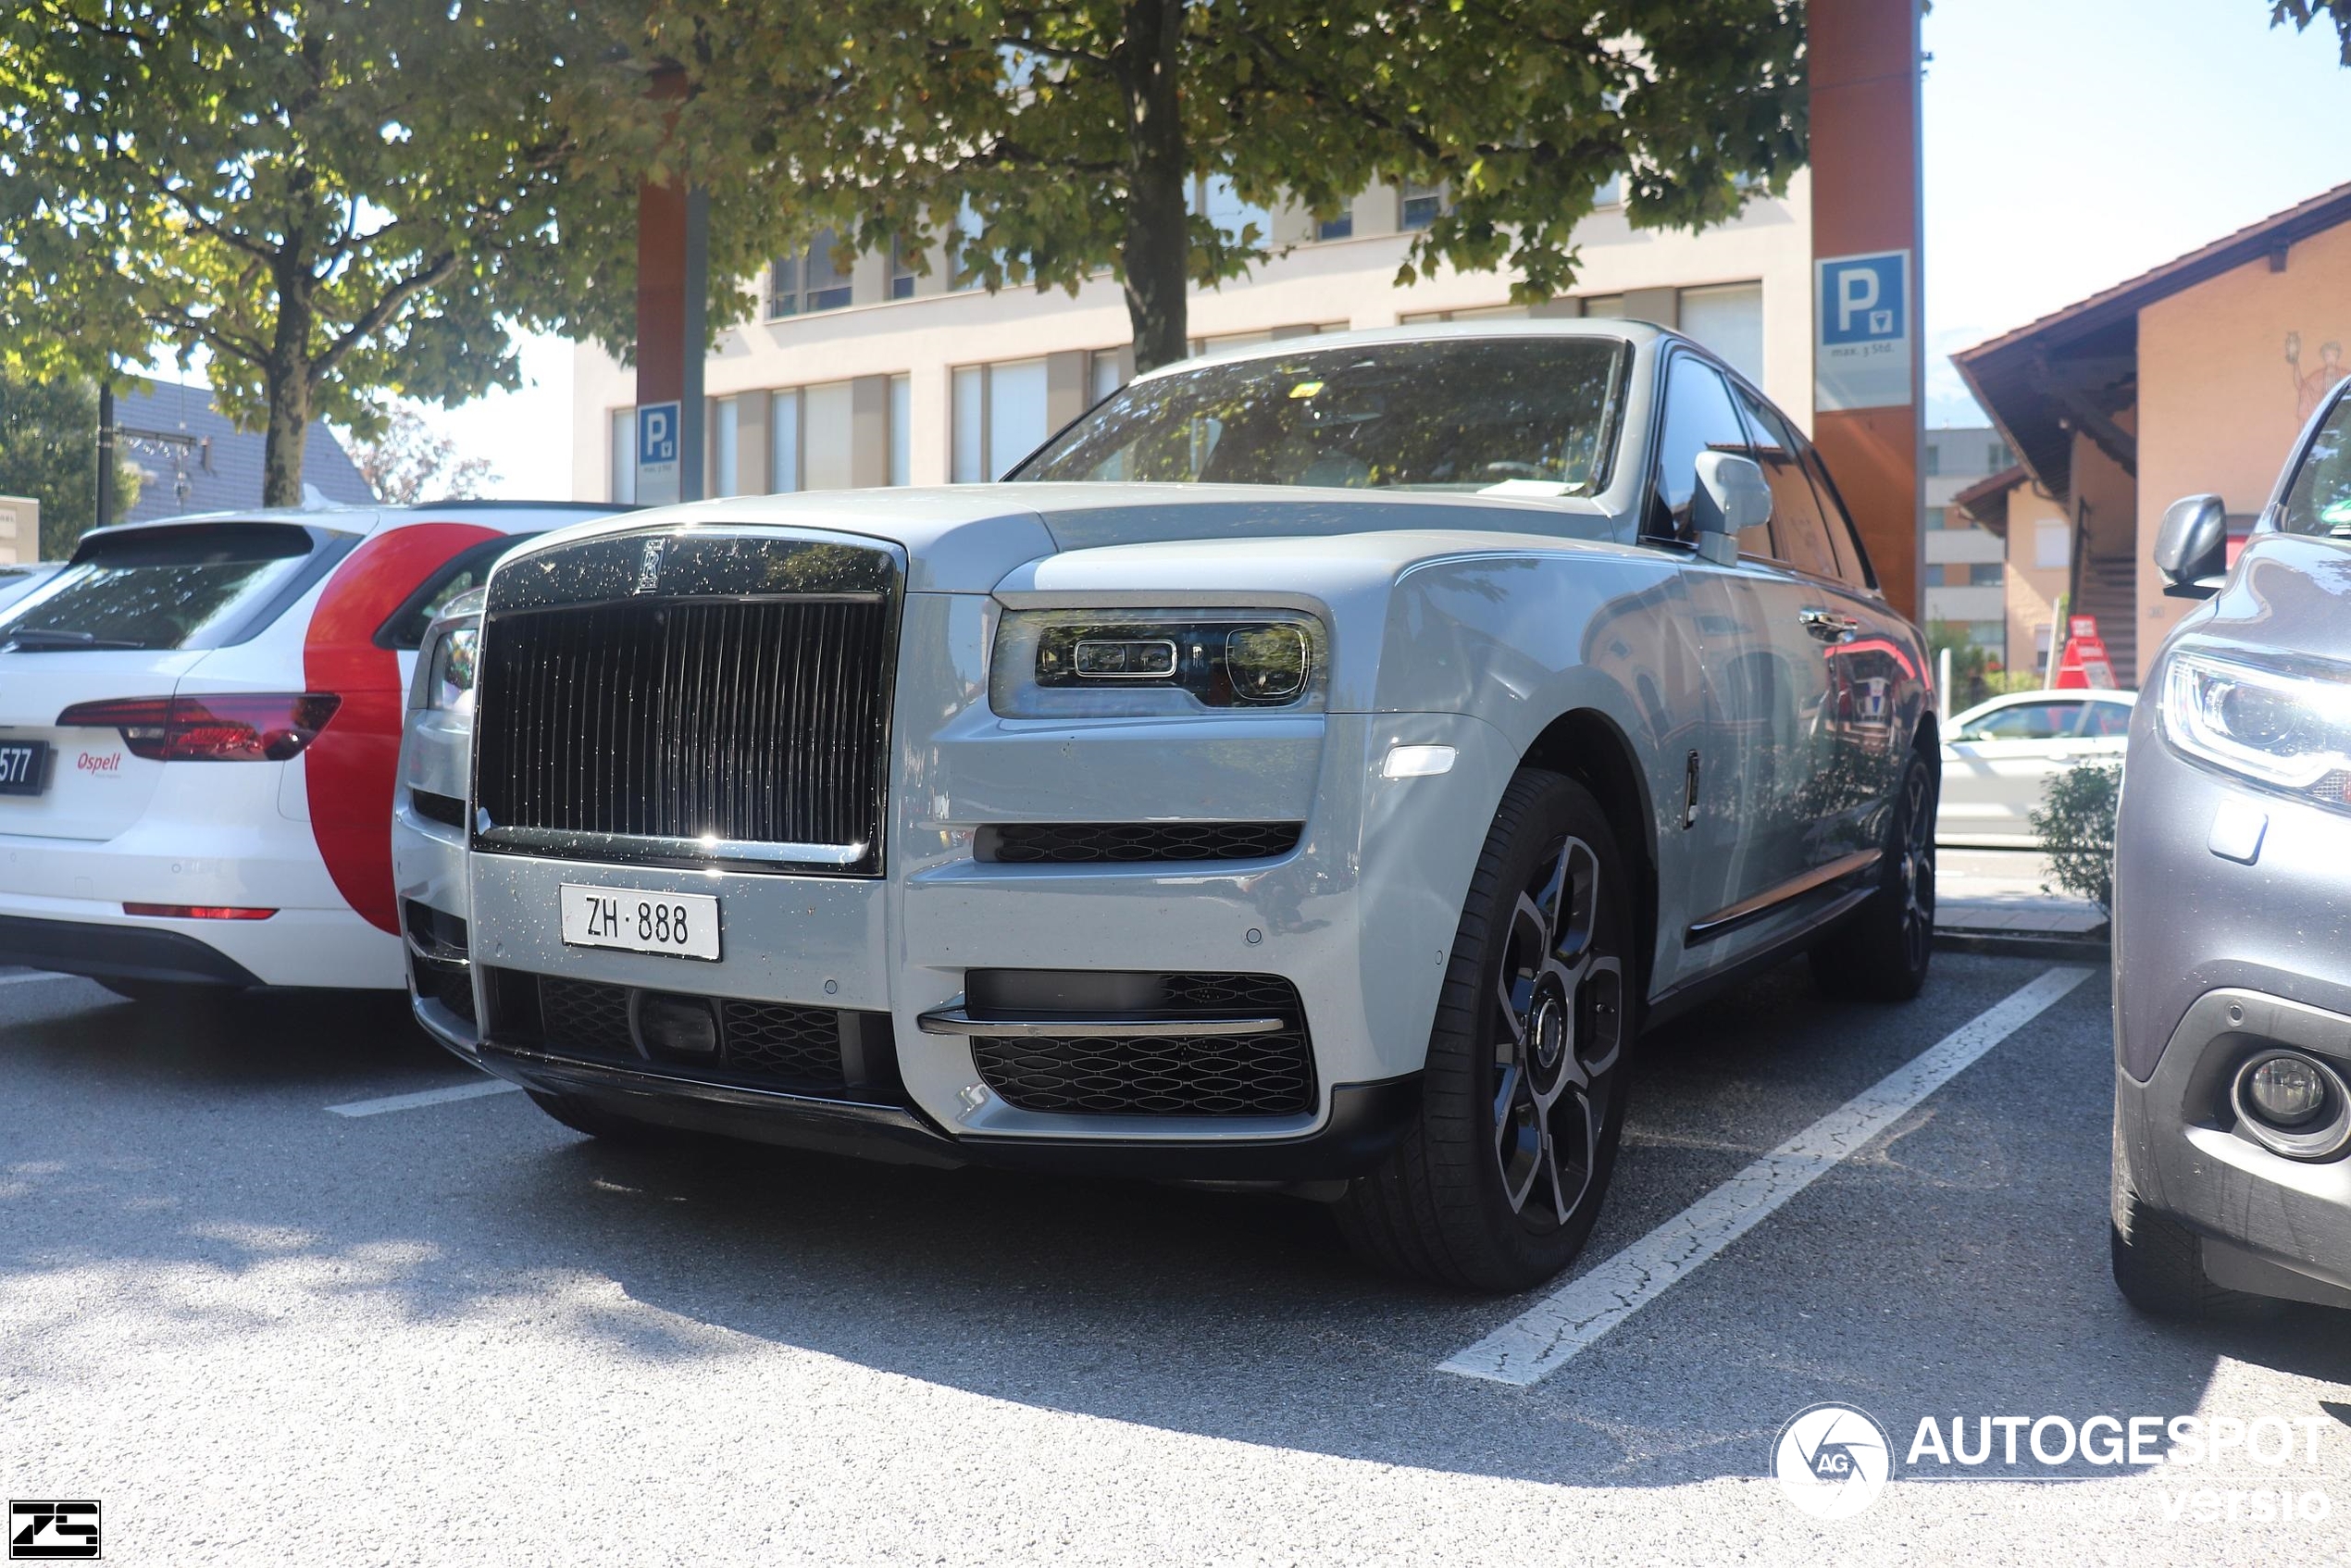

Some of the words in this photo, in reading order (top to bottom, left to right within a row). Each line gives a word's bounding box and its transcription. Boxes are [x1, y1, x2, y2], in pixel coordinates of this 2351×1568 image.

[1838, 268, 1880, 331] P
[1831, 347, 1860, 357] max.
[1872, 342, 1895, 355] Std.
[647, 413, 667, 456] P
[78, 753, 120, 775] Ospelt
[586, 897, 618, 938] ZH
[638, 902, 688, 944] 888
